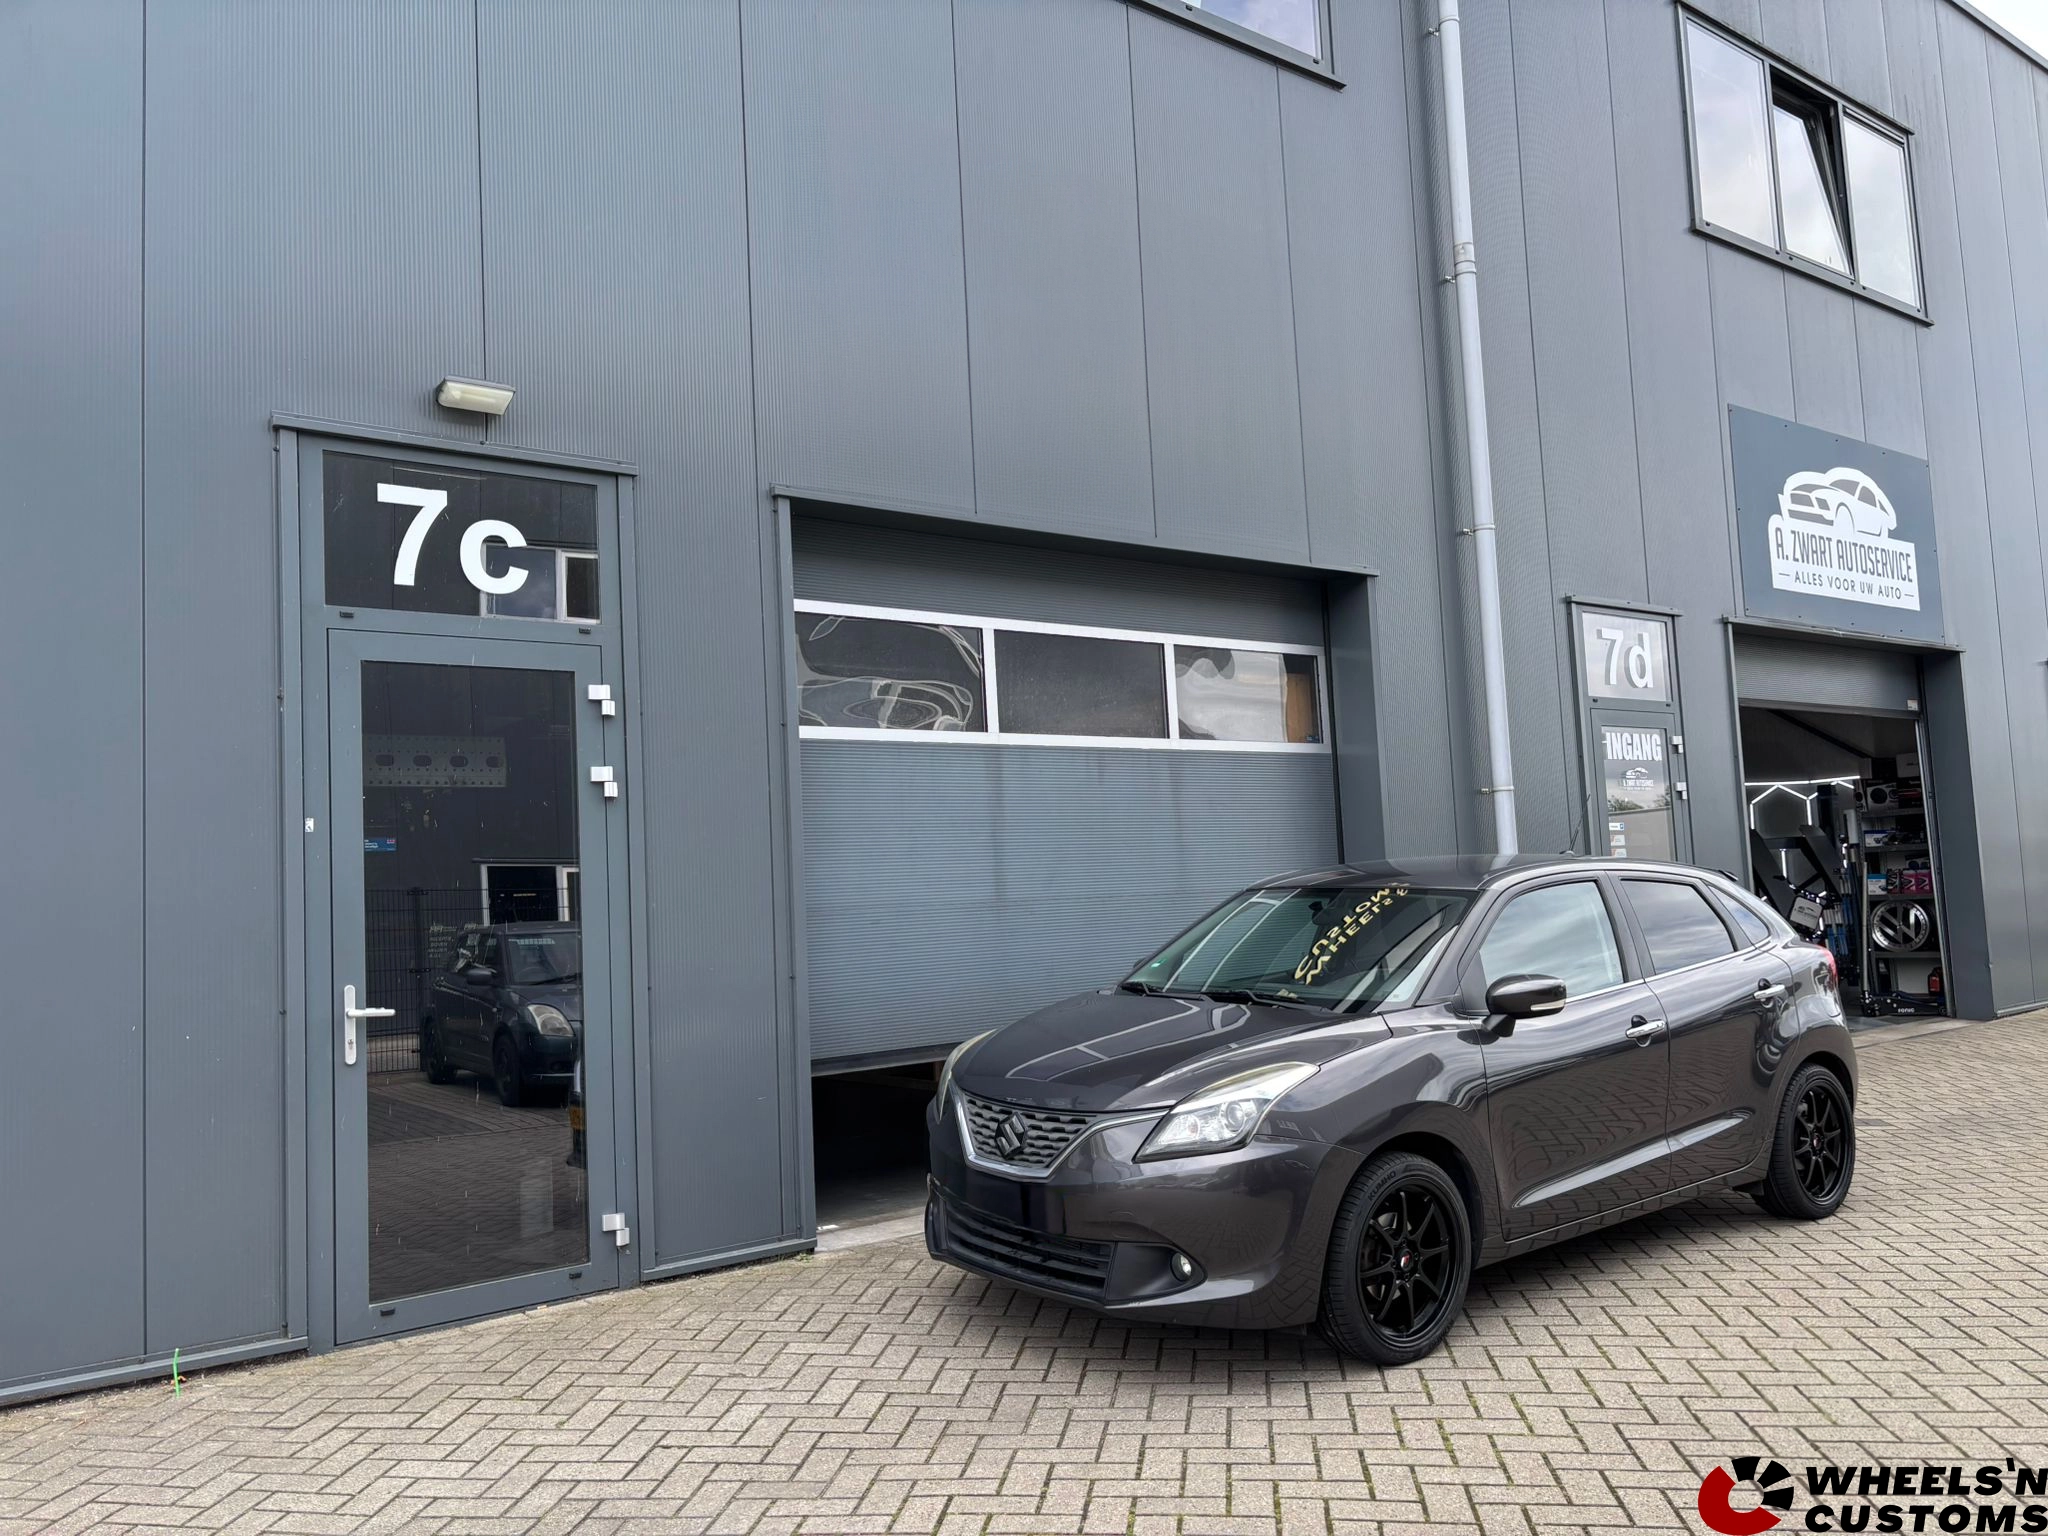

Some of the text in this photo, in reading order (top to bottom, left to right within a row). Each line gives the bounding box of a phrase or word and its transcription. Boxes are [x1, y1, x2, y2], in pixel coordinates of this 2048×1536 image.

[376, 482, 529, 595] 7c
[1774, 527, 1913, 583] A. ZWART AUTOSERVICE
[1794, 570, 1902, 600] ALLES VOOR UW AUTO
[1598, 627, 1654, 688] 7d
[1605, 731, 1663, 762] INGANG
[1367, 1171, 1397, 1202] KUMHO
